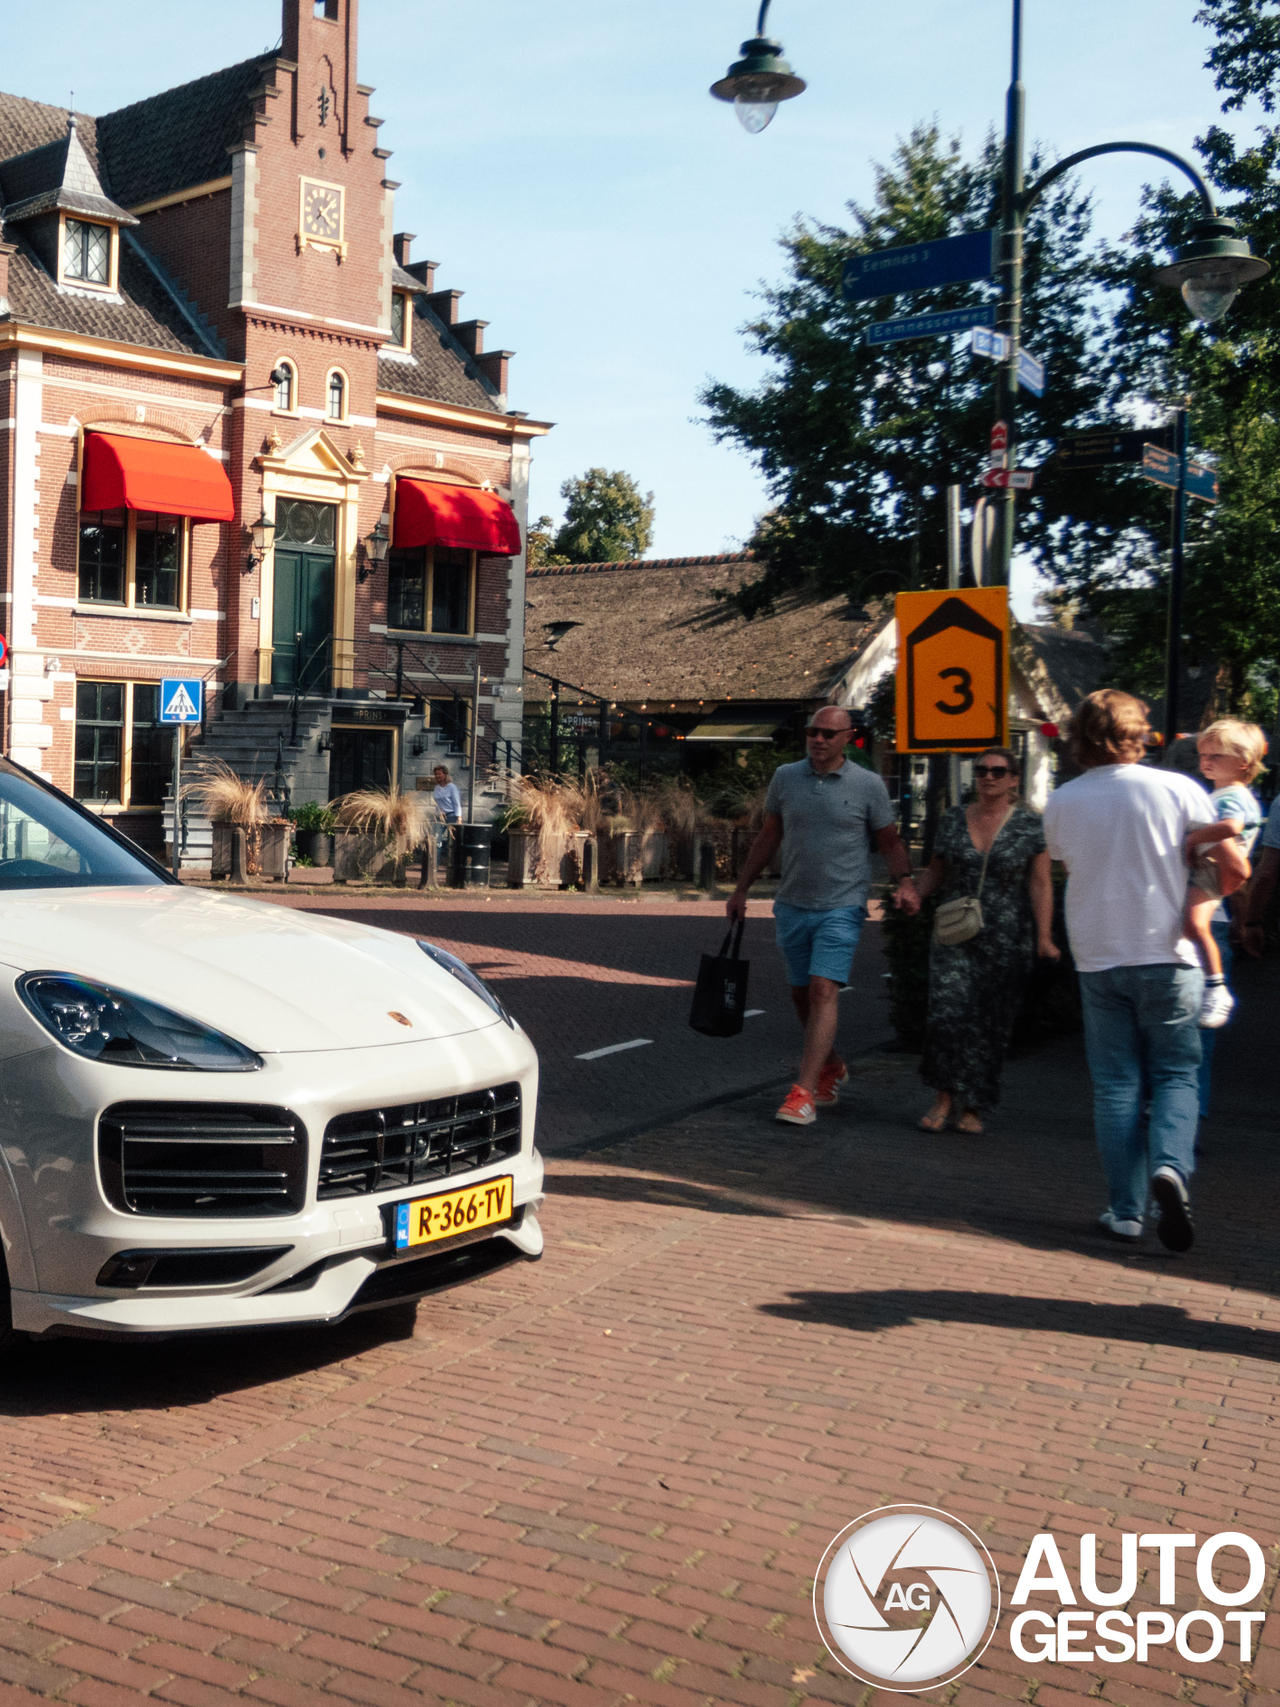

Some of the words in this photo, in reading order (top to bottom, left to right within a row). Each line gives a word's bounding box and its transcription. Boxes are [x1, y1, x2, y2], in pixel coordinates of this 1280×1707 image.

[862, 252, 918, 273] Eemnes
[935, 667, 974, 715] 3
[567, 716, 593, 727] PRINS
[418, 1184, 506, 1238] R-366-TV
[398, 1229, 408, 1241] NL
